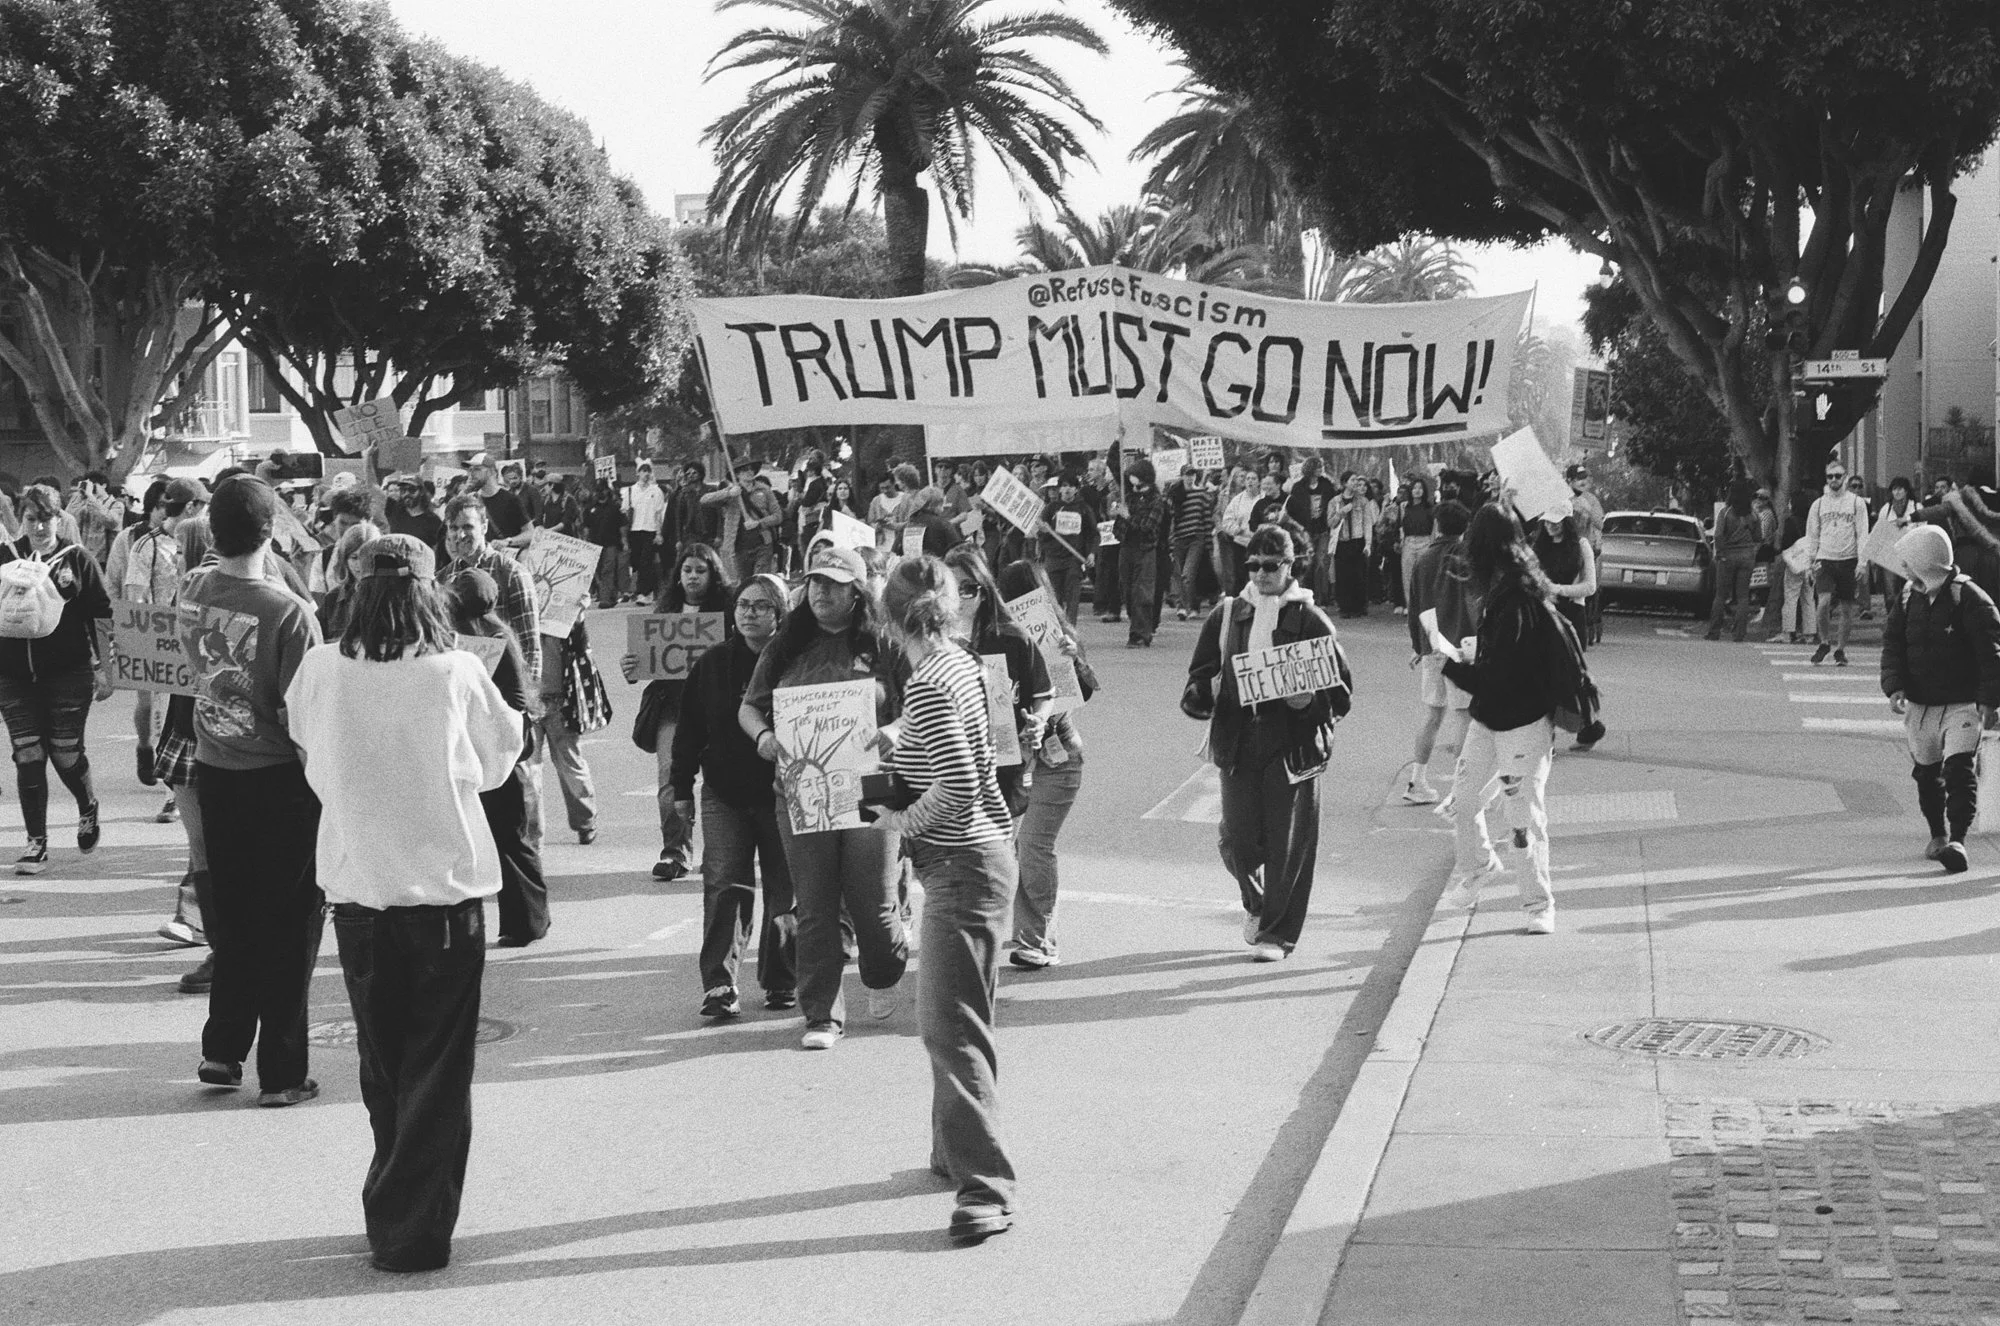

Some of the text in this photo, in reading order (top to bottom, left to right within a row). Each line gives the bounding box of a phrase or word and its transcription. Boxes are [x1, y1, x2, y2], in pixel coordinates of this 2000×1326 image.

[725, 317, 1001, 407] TRUMP
[1028, 311, 1191, 403] MUST
[1201, 331, 1304, 425] GO
[1323, 339, 1495, 428] NOW!
[1816, 362, 1876, 374] 14th St
[350, 403, 378, 421] NO
[347, 415, 386, 437] ICE
[643, 616, 718, 642] FUCK
[156, 637, 182, 654] FOR
[1235, 637, 1332, 673] I LIKE MY
[1238, 655, 1338, 703] ICE CRUSHED!
[813, 715, 859, 733] NATION
